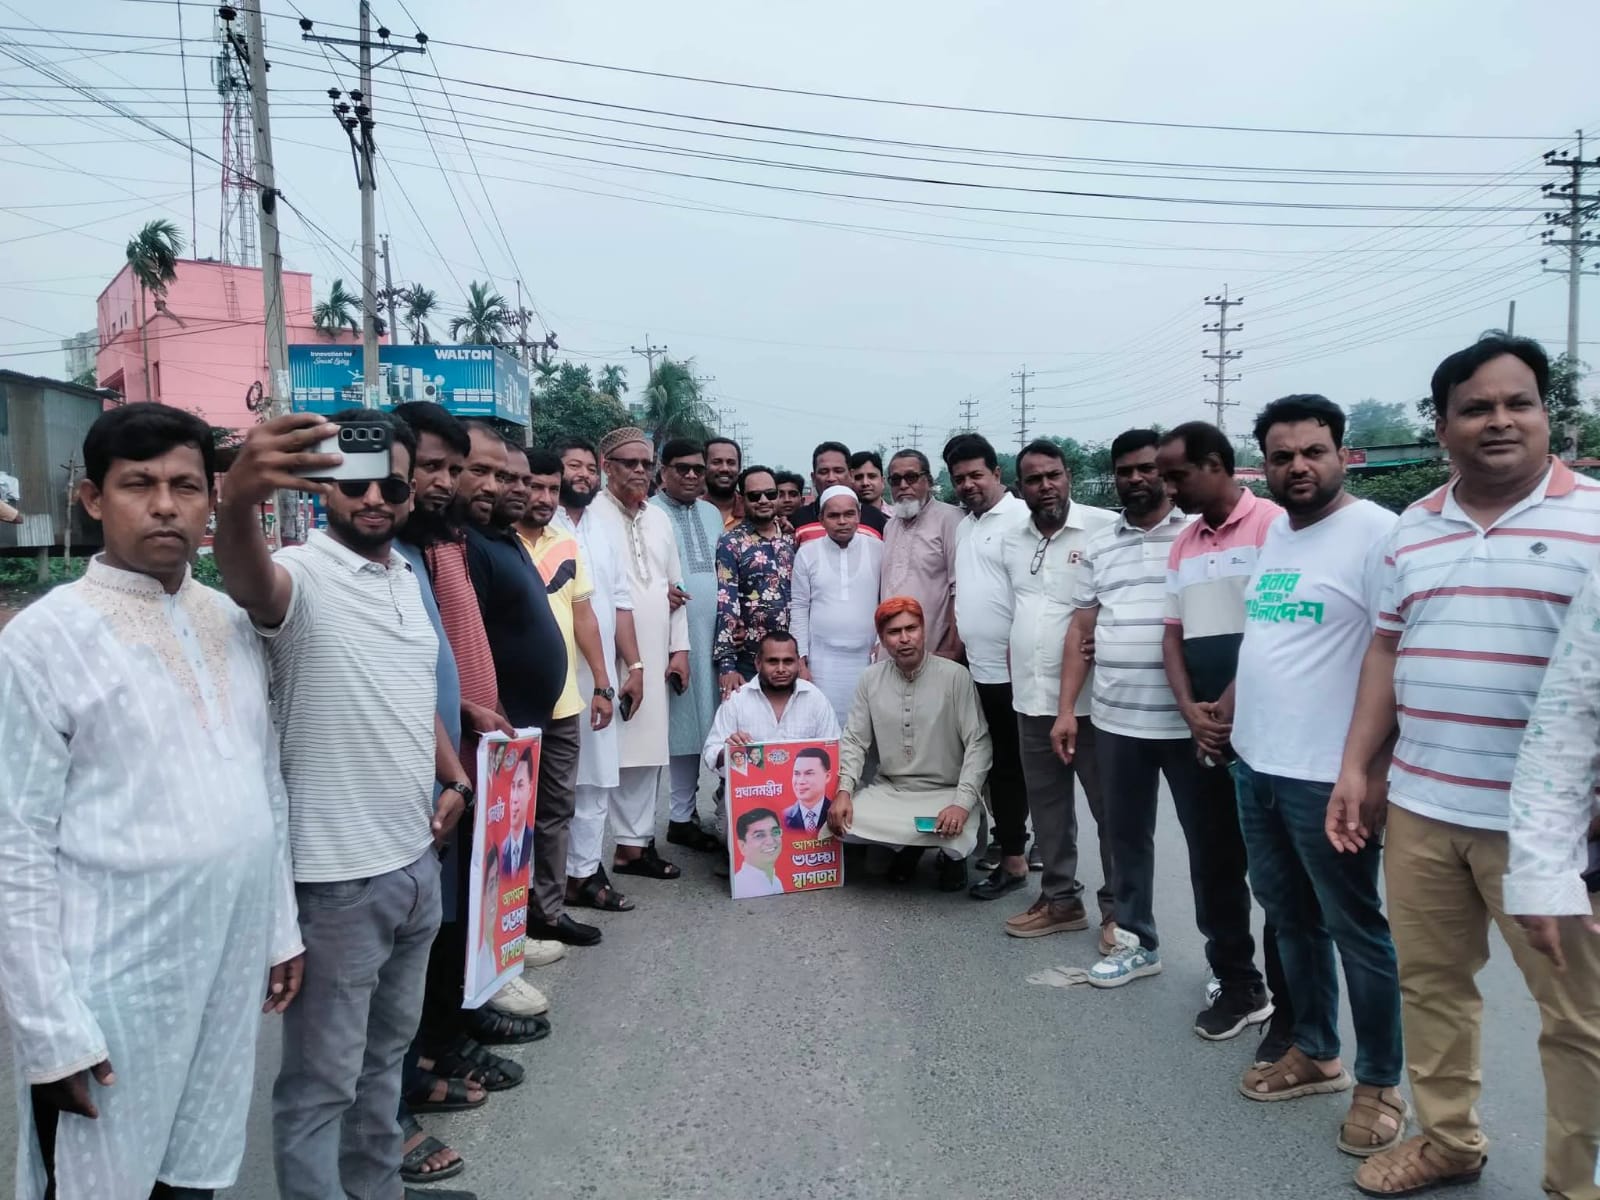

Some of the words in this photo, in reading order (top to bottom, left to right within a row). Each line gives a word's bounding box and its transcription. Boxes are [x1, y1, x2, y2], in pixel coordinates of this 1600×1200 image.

[434, 349, 493, 360] WALTON
[735, 779, 783, 798] প্রধানমন্ত্রীর
[792, 869, 837, 889] স্বাগতম
